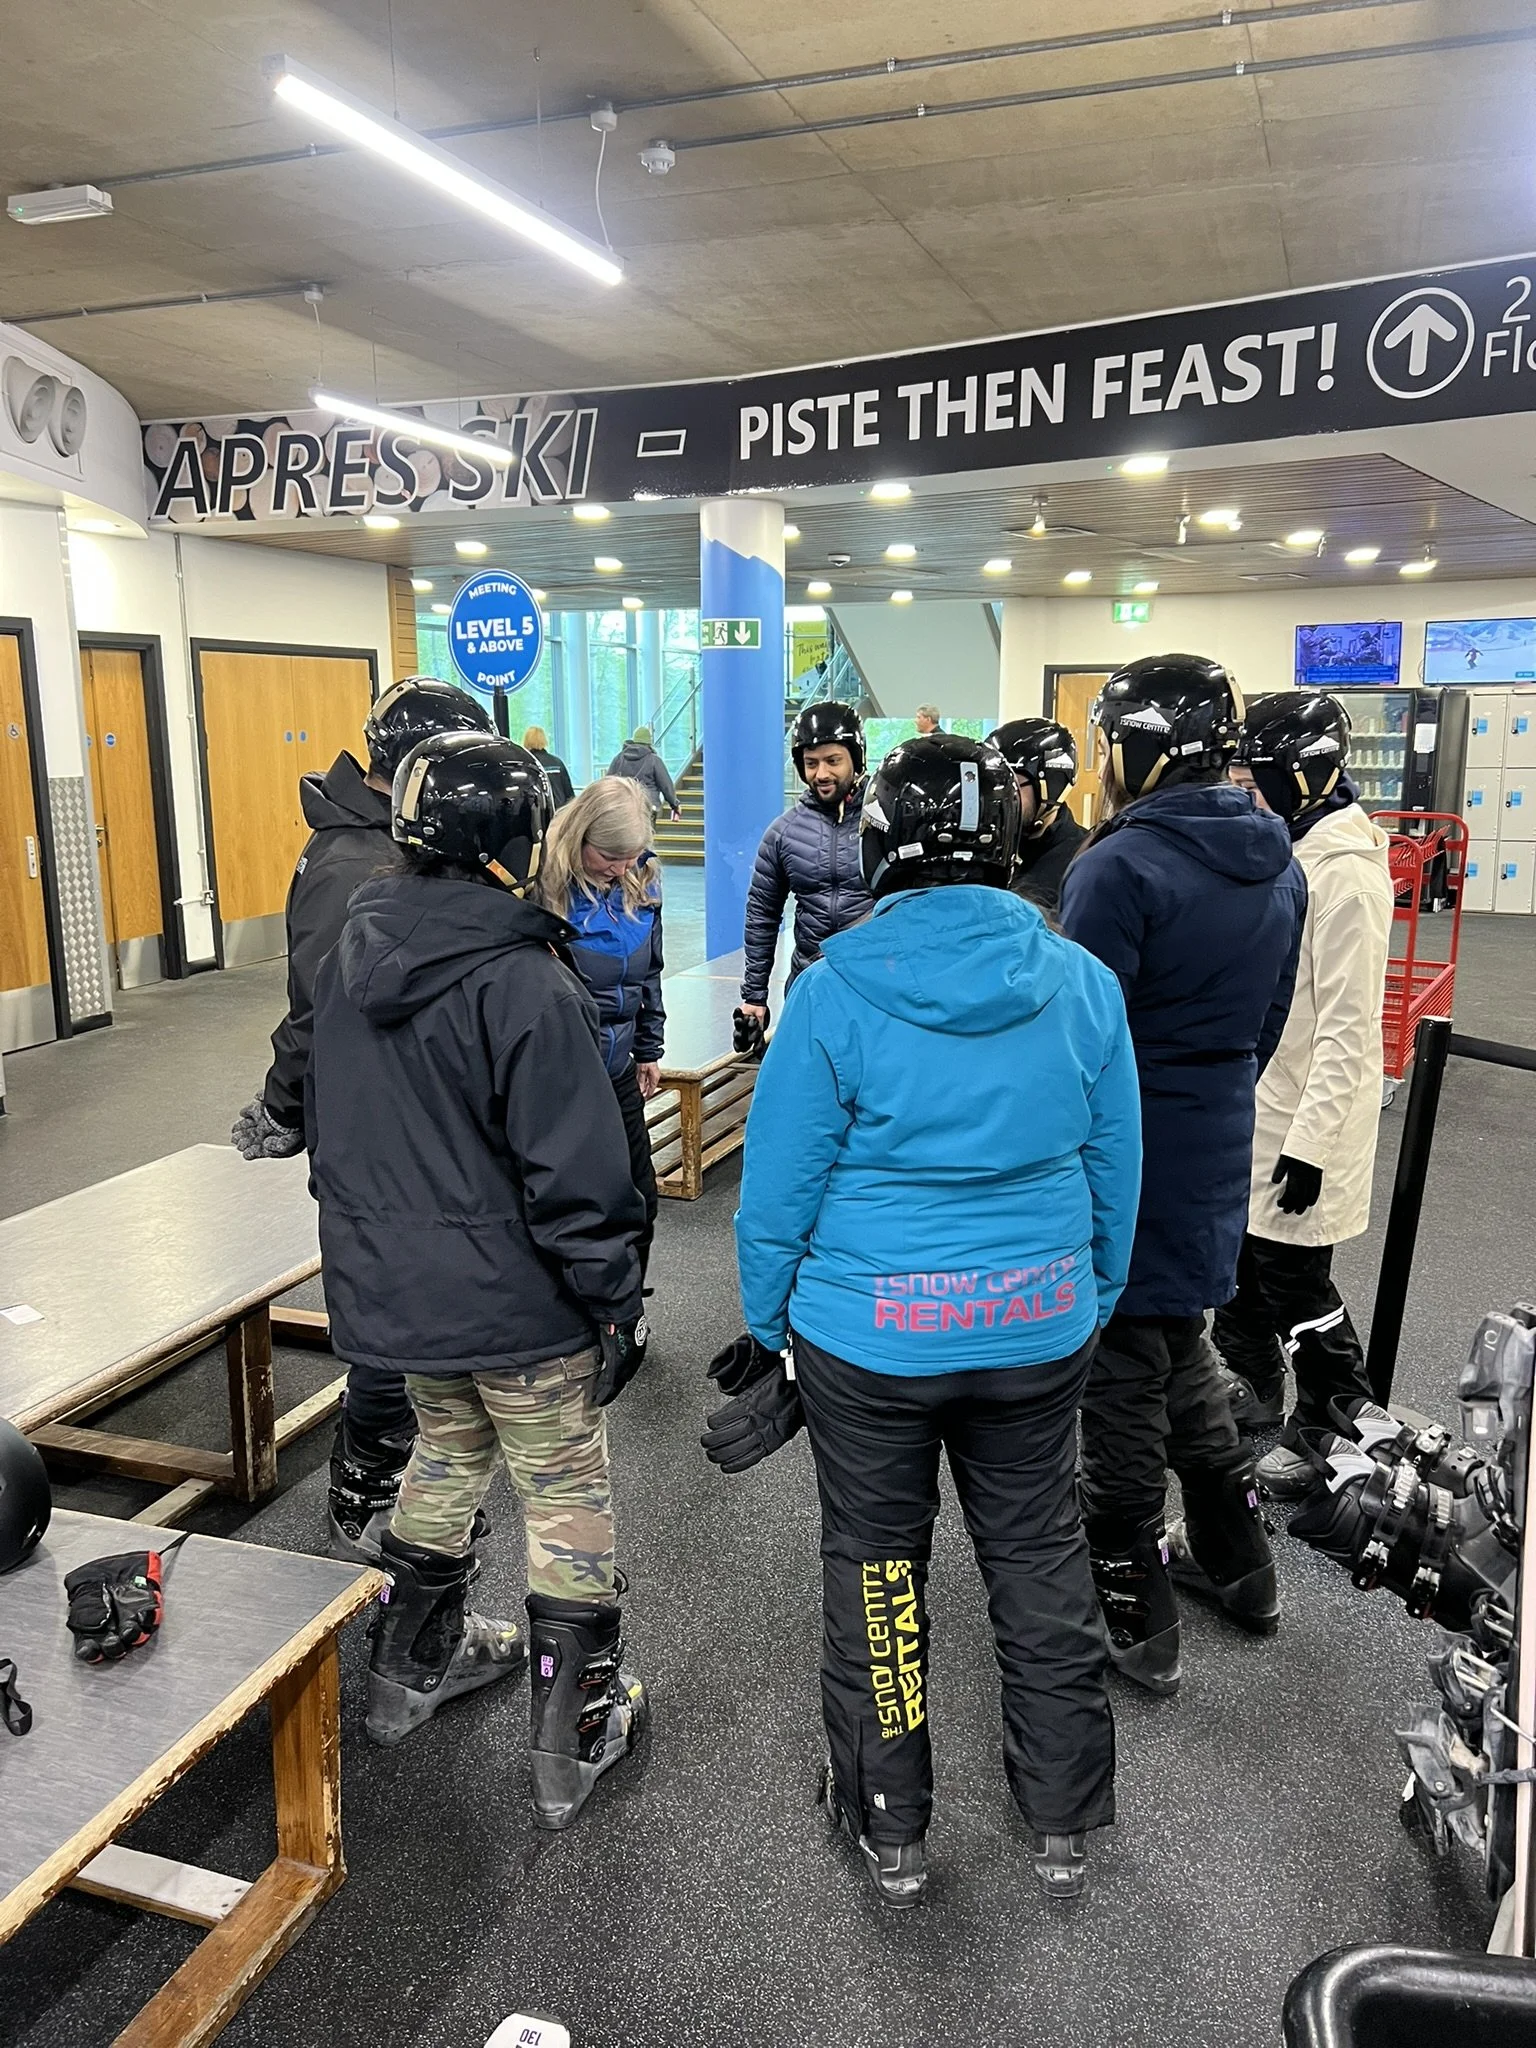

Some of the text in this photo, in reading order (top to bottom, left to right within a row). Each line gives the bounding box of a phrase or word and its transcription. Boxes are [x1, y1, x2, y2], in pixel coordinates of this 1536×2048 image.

[448, 407, 599, 505] SKI
[739, 390, 880, 460] PISTE
[898, 364, 1067, 441] THEN
[1091, 322, 1339, 420] FEAST!
[468, 582, 518, 600] MEETING
[455, 615, 535, 640] LEVEL 5
[466, 638, 525, 655] & ABOVE
[476, 669, 516, 687] POINT
[875, 1281, 1077, 1332] RENTALS
[519, 2028, 542, 2046] 130
